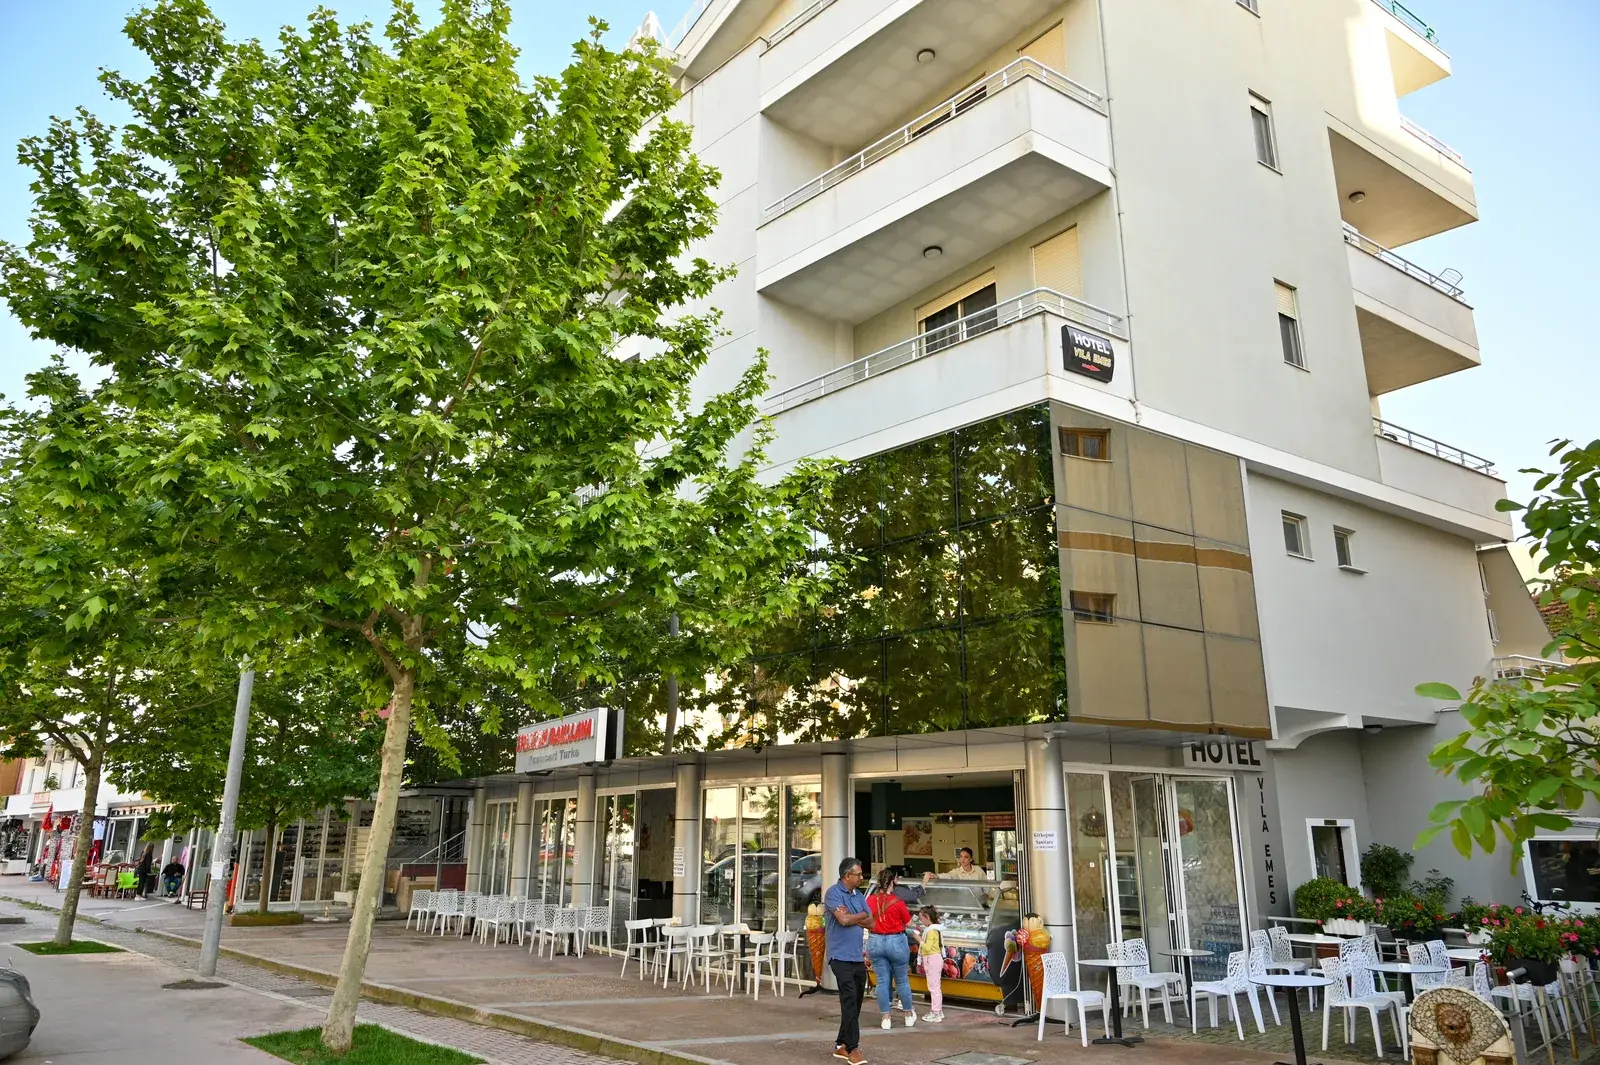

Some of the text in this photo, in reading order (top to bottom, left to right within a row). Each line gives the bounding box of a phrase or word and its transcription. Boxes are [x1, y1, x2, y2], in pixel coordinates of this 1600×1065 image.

[1073, 332, 1110, 355] HOTEL
[1074, 347, 1091, 361] VILA
[1188, 740, 1261, 766] HOTEL
[1256, 777, 1276, 905] VILA EMES
